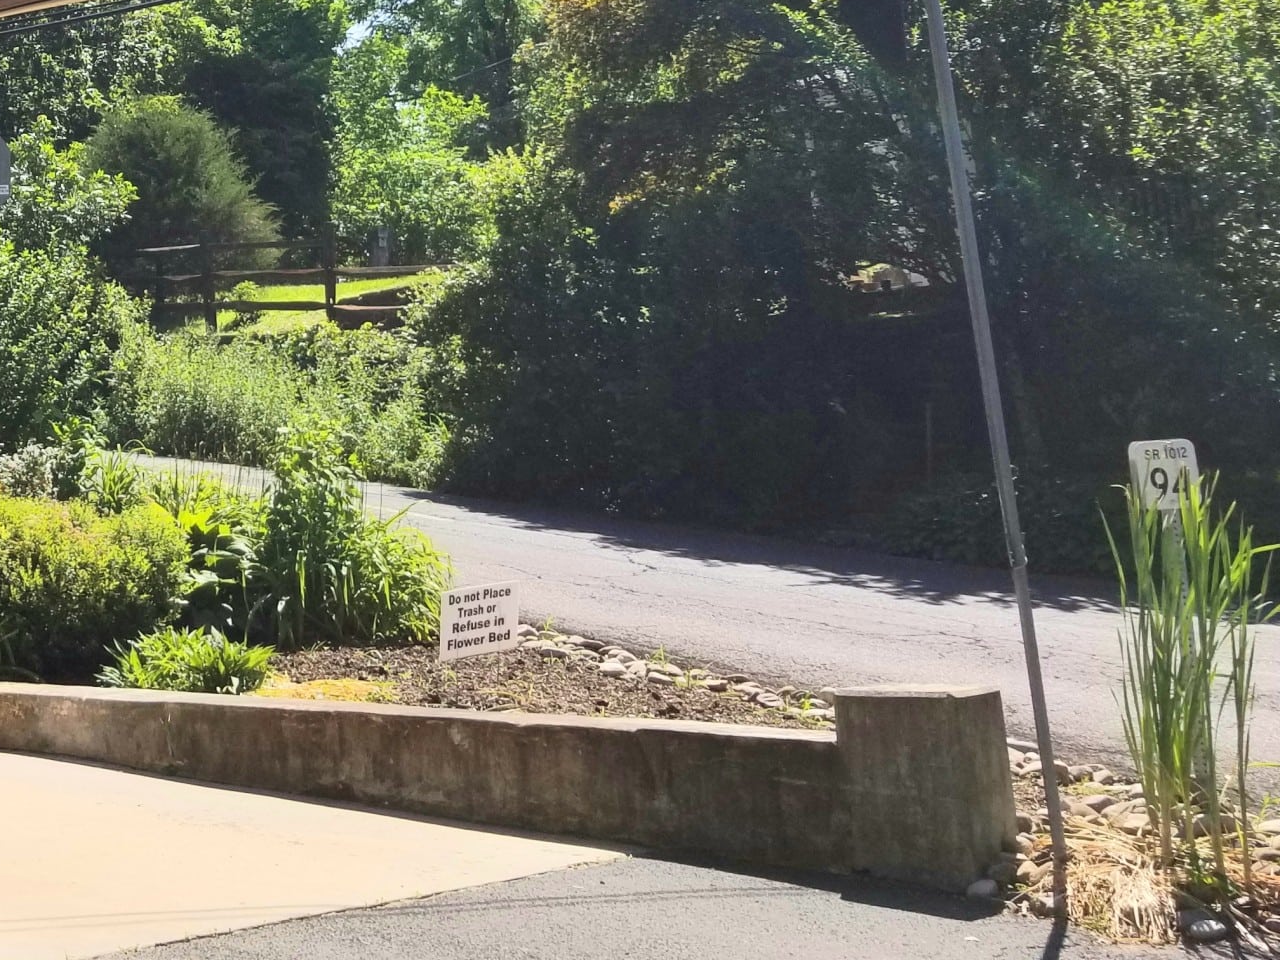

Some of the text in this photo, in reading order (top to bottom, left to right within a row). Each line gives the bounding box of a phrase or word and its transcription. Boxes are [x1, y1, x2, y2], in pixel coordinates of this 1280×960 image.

[1144, 446, 1188, 460] SR 1012
[449, 588, 511, 605] Do not Place
[458, 604, 496, 618] Trash or
[452, 616, 504, 634] Refuse in
[447, 629, 510, 651] Flower Bed
